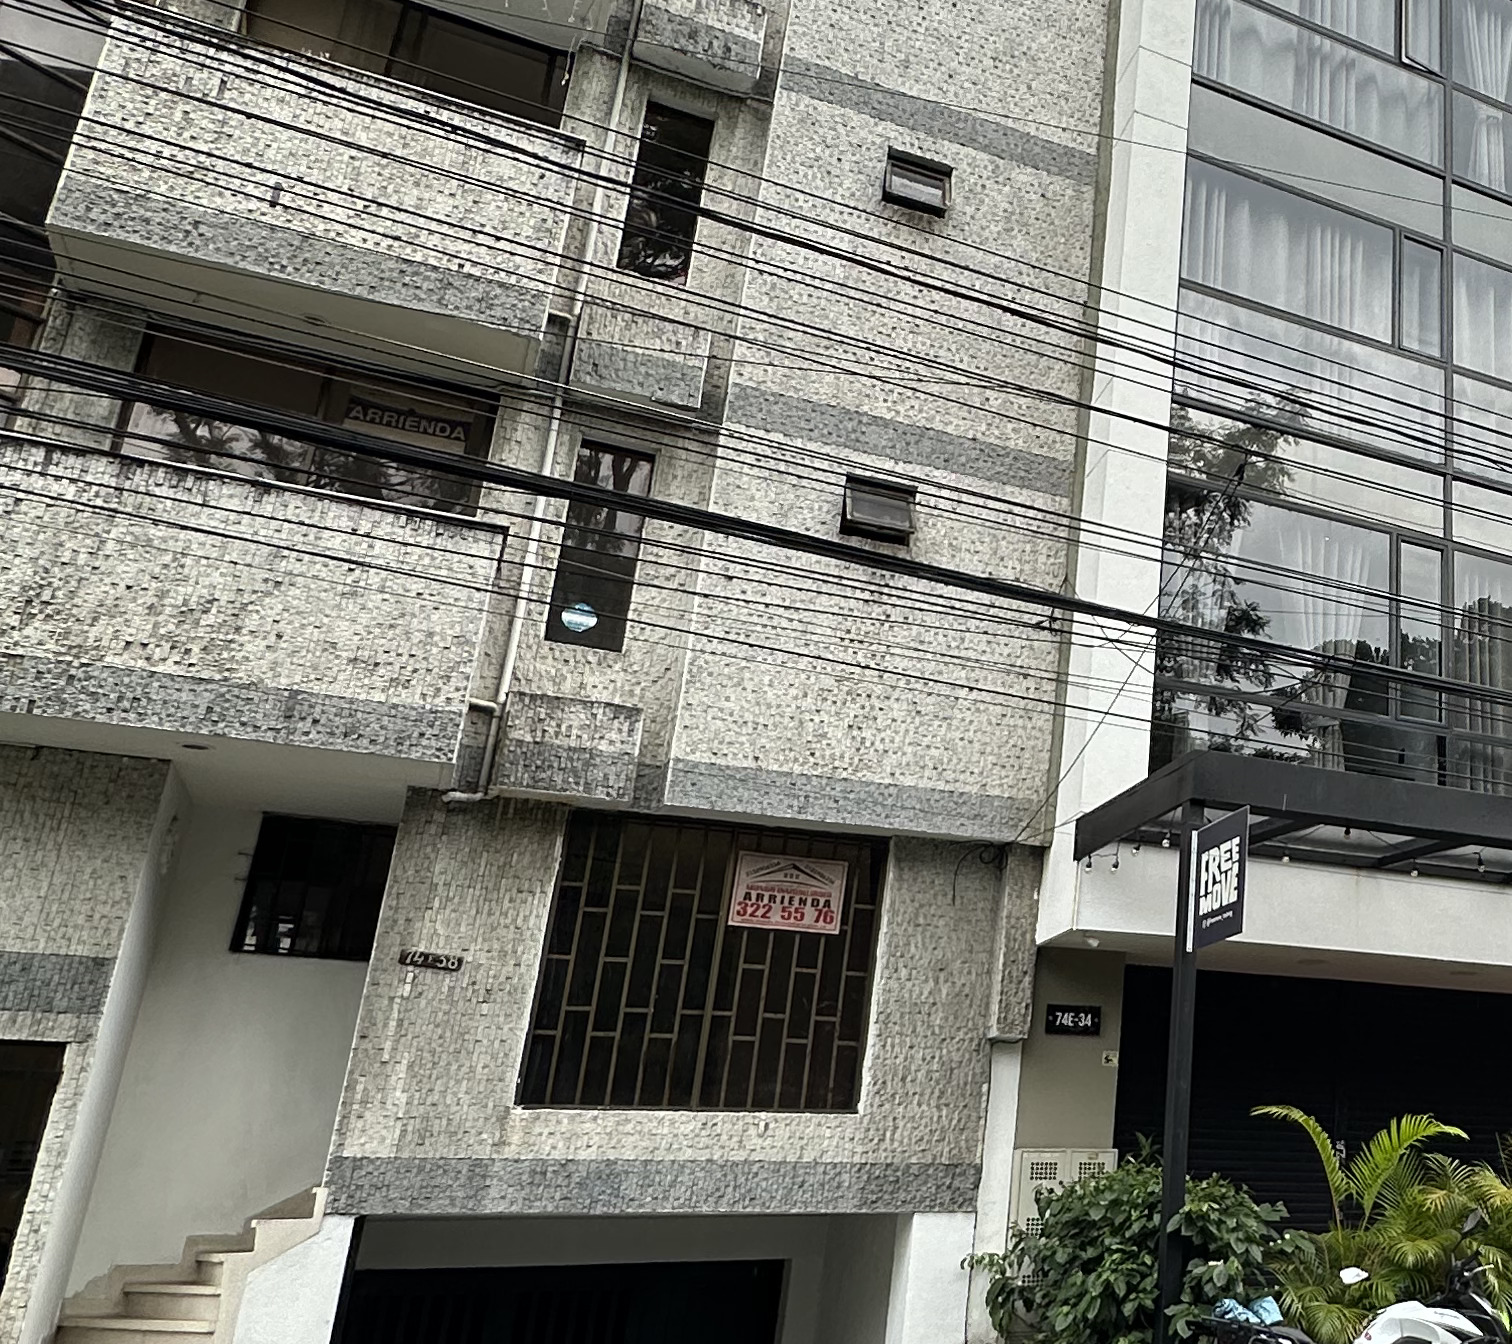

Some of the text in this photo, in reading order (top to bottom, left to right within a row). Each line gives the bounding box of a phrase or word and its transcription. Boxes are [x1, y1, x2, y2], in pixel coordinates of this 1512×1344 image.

[349, 405, 466, 441] ARRIENDA
[1200, 836, 1240, 896] FREE
[743, 891, 832, 909] ARRIENDA
[1199, 861, 1239, 916] MOVE
[736, 900, 773, 919] 322
[780, 905, 806, 922] 55
[814, 908, 836, 925] 76
[1055, 1011, 1092, 1027] 74E-34
